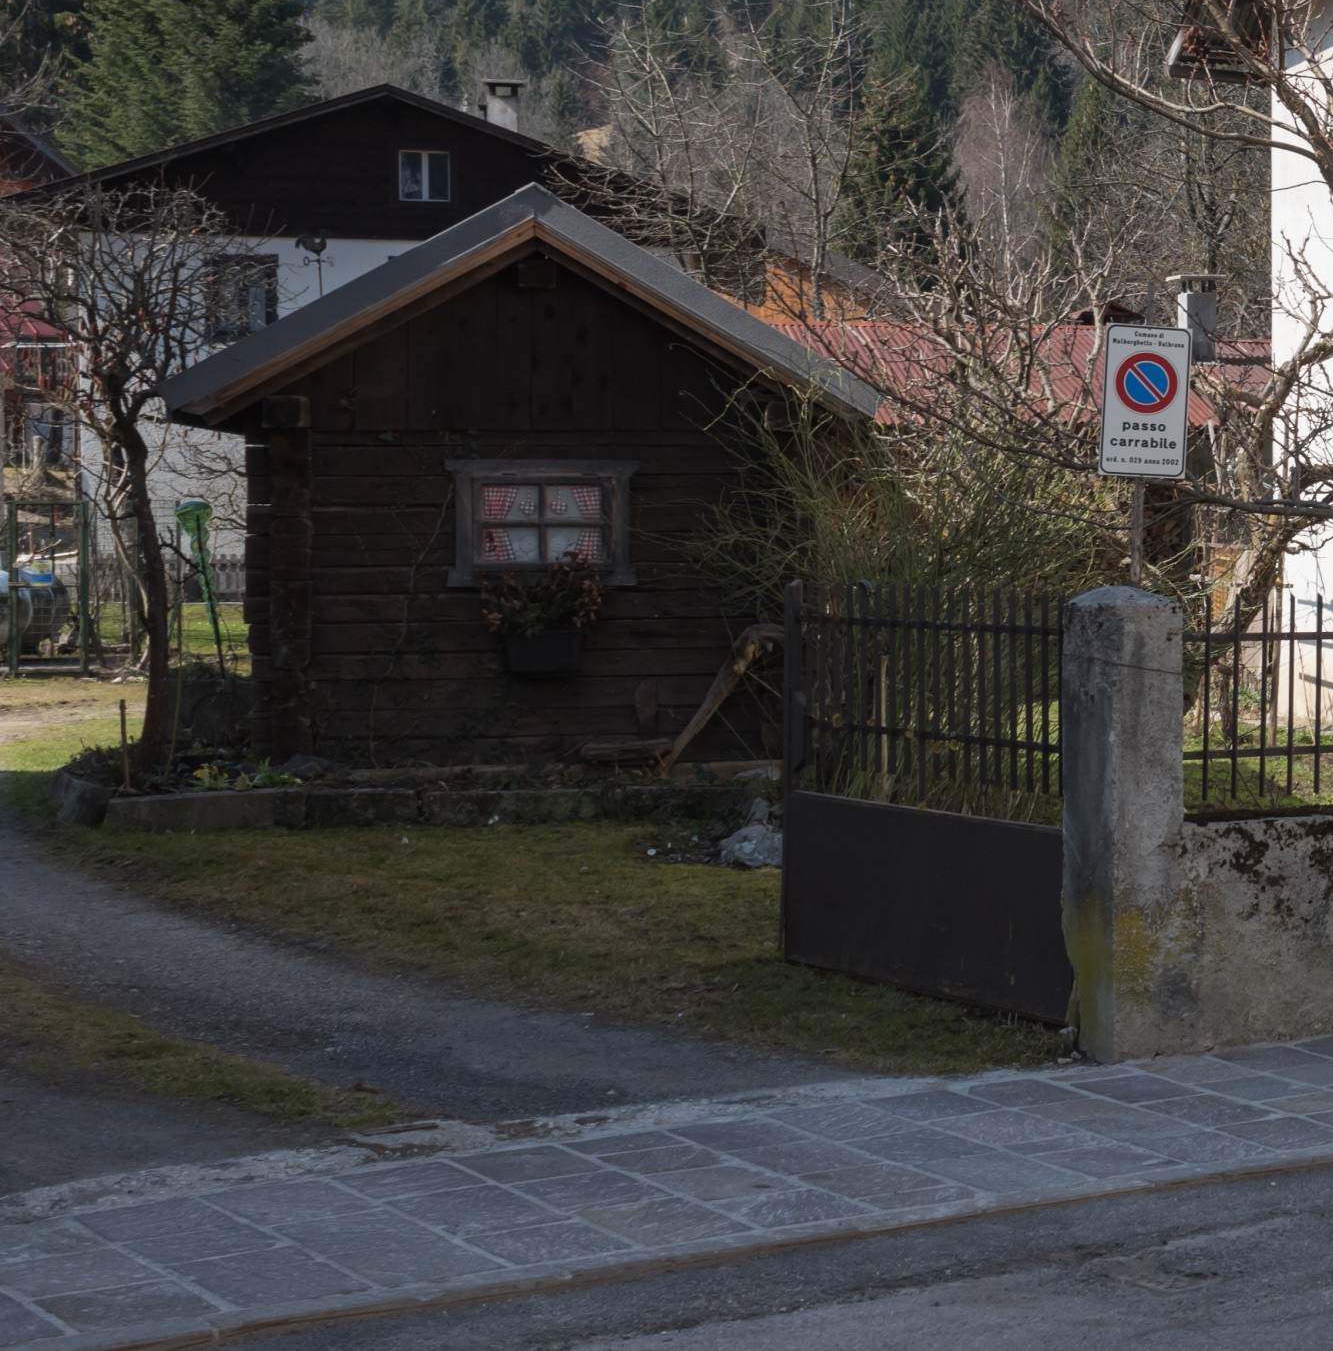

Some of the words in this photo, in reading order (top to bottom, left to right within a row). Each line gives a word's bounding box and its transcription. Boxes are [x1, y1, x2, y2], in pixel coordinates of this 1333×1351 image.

[1113, 338, 1153, 346] Malborghetto
[1122, 421, 1166, 432] passo
[1110, 437, 1177, 449] carrabile
